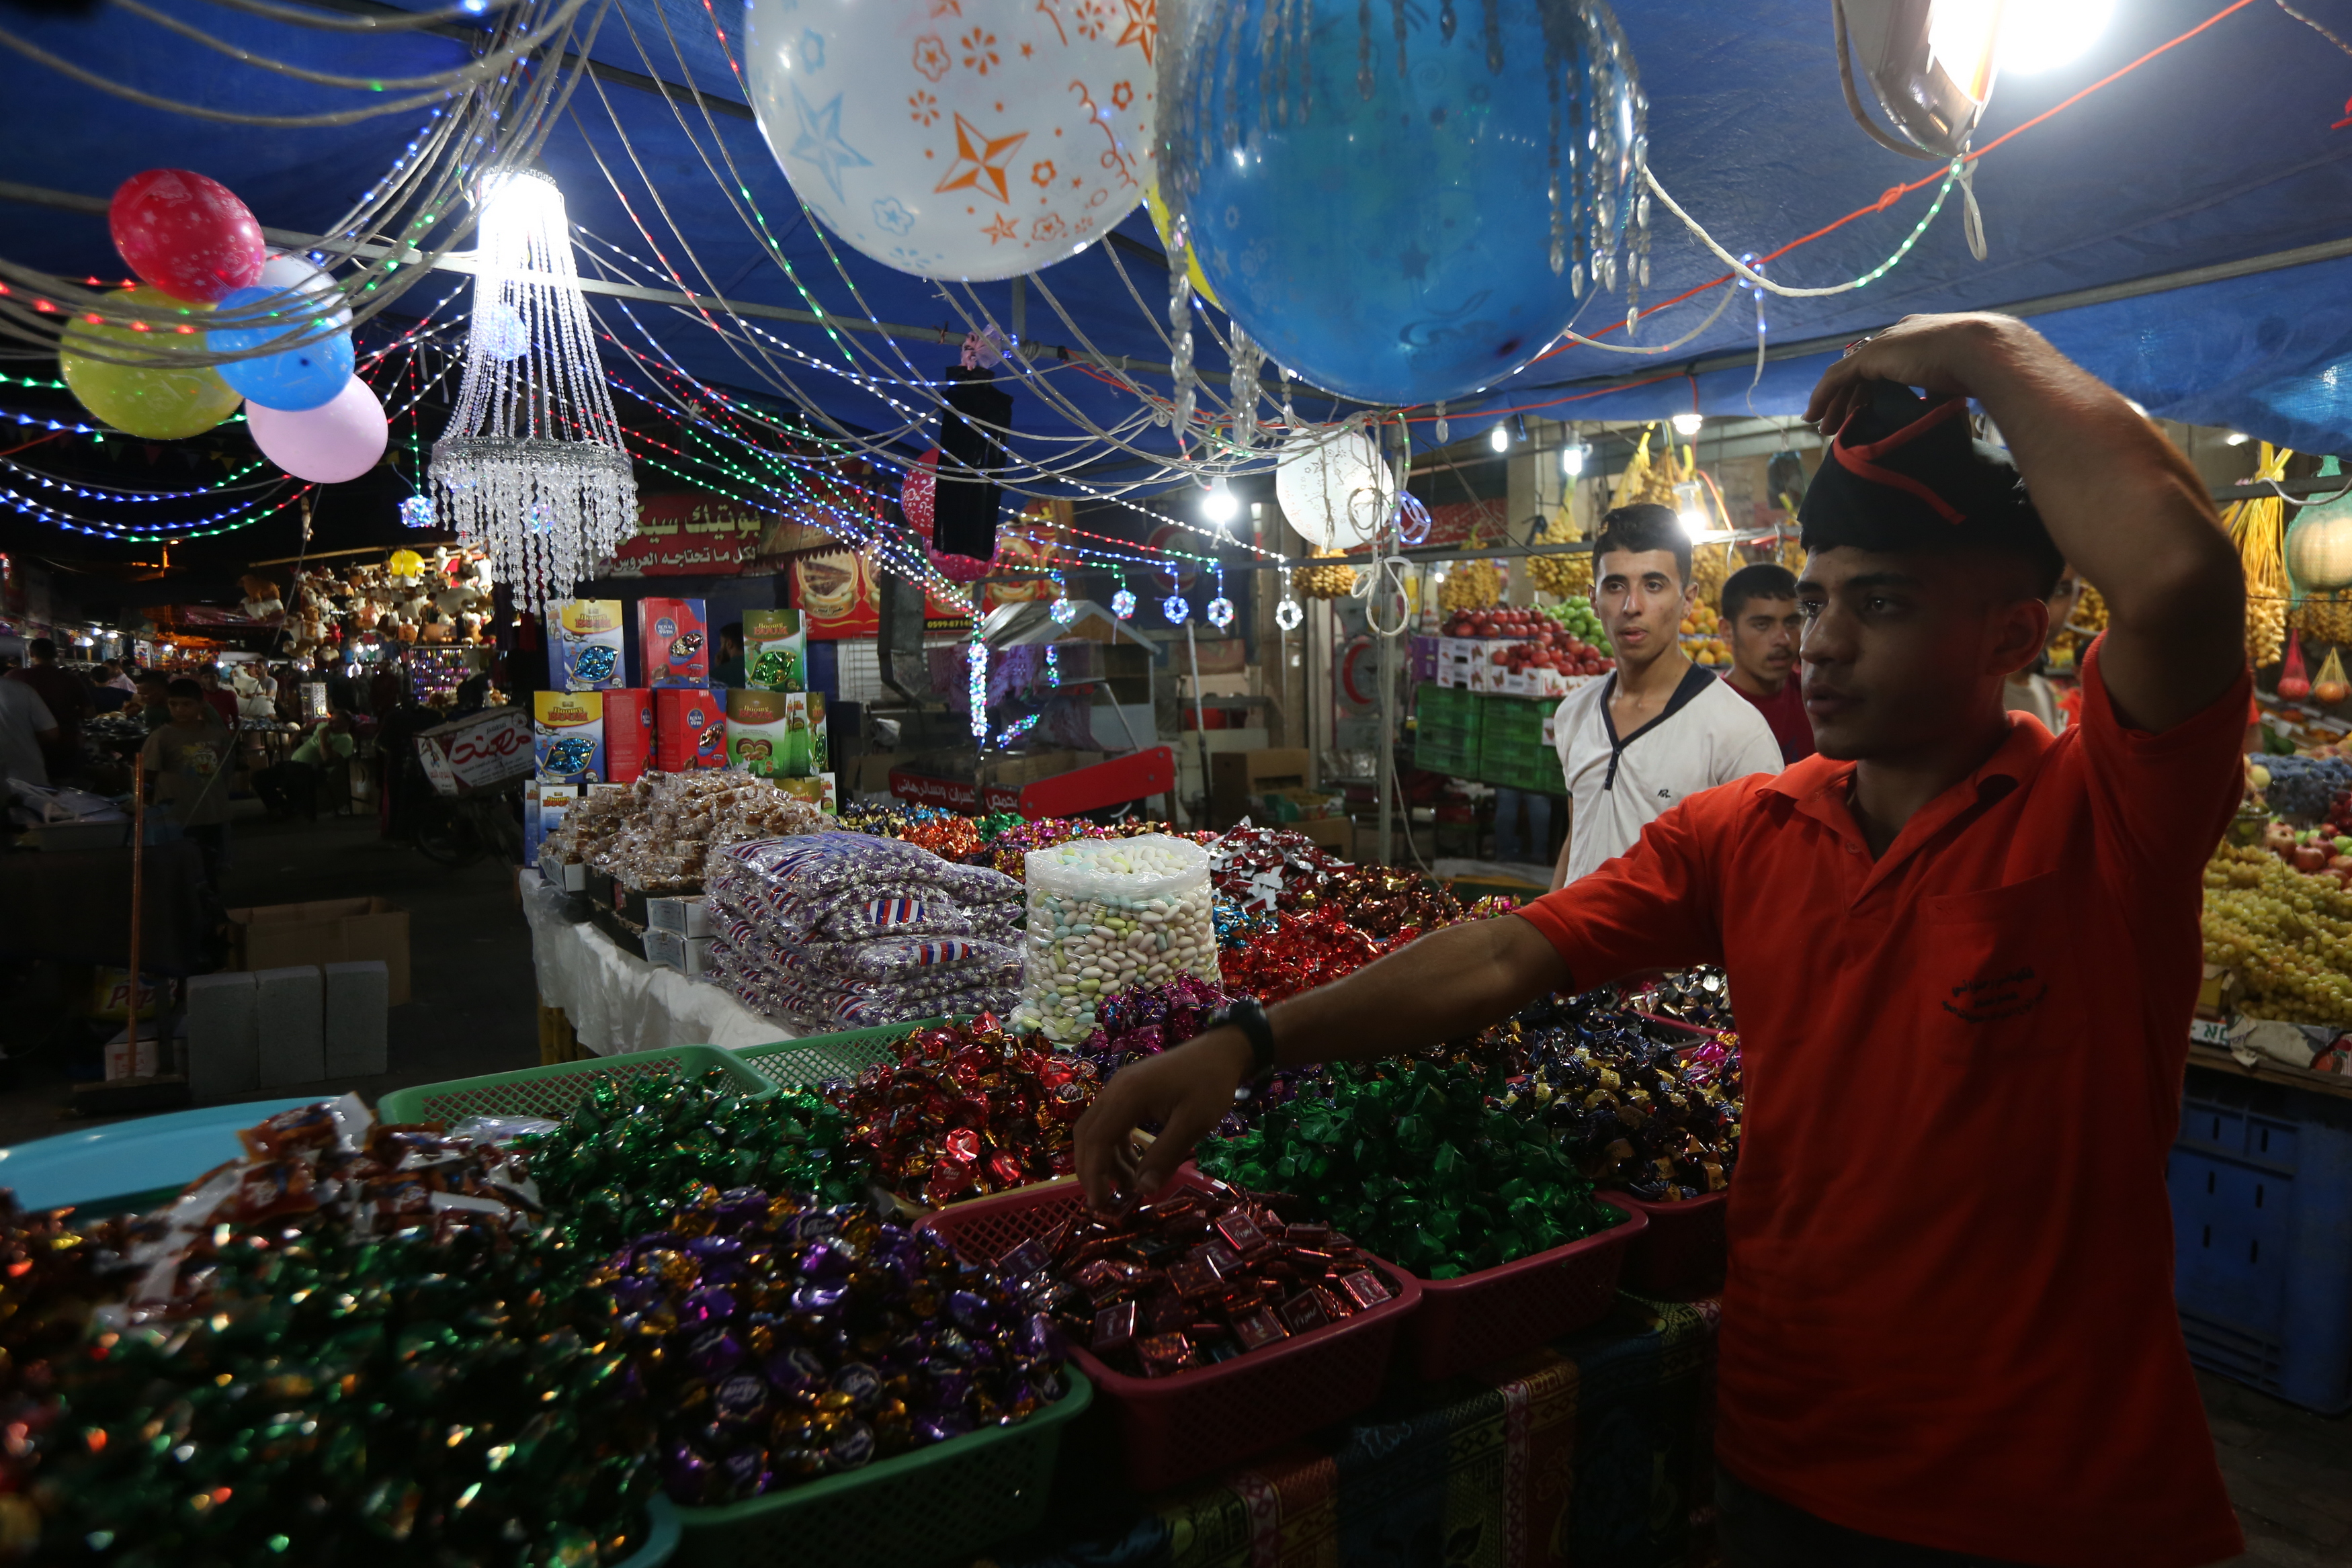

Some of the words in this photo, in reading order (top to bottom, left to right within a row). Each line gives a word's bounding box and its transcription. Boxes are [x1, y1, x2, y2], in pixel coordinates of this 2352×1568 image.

[685, 503, 761, 540] بوتيك
[614, 551, 659, 572] العروس
[661, 547, 711, 568] تحتاجه
[713, 548, 730, 562] ما
